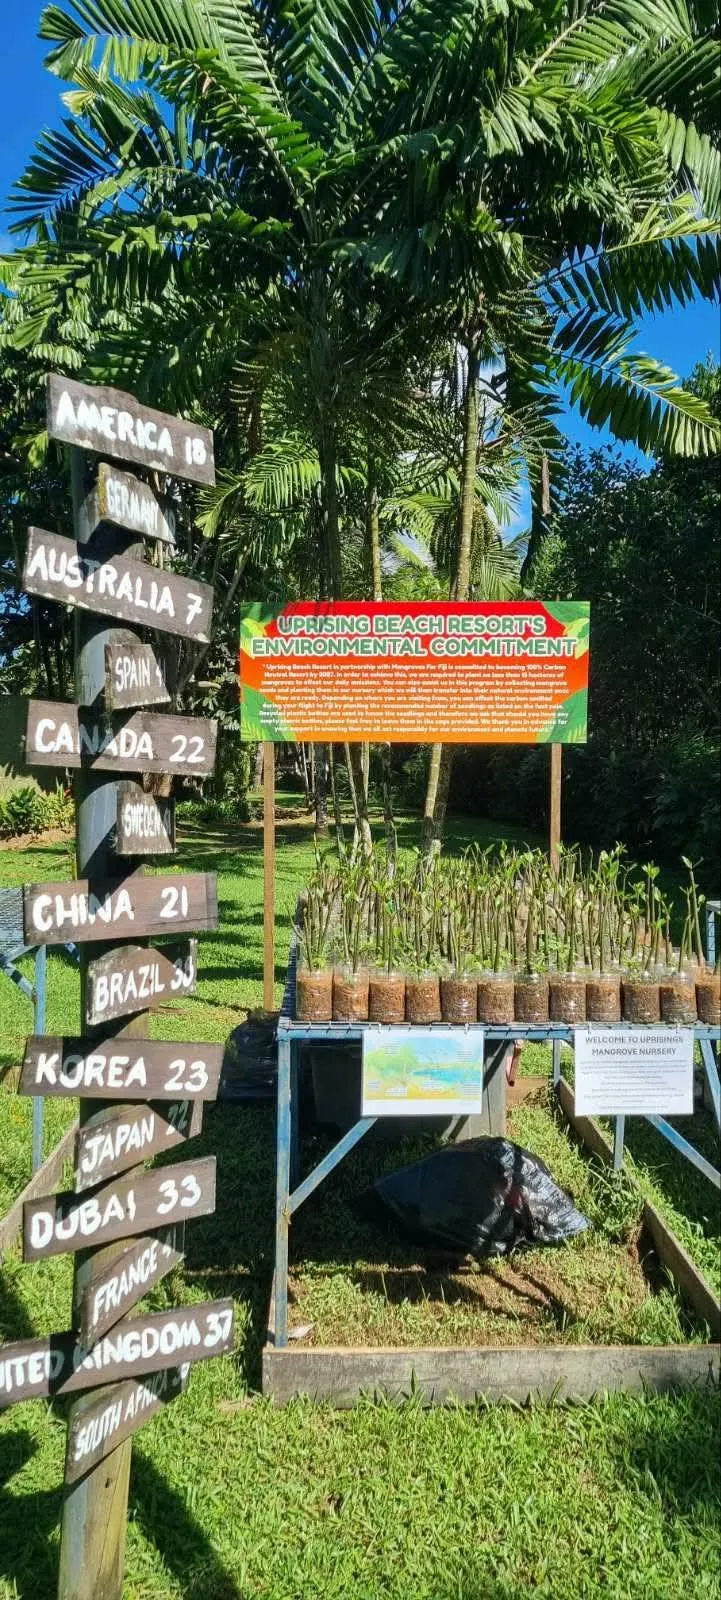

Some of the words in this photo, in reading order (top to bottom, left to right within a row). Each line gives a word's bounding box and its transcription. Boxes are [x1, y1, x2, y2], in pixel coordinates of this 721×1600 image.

[55, 391, 174, 457] AMERICA
[184, 436, 206, 465] 18
[106, 478, 159, 534] GERMANY
[27, 544, 175, 618] AUSTRALIA
[186, 592, 203, 624] 7
[252, 637, 426, 656] ENVIRONMENTAL
[430, 637, 577, 656] COMMITMENT
[277, 615, 372, 635] UPRISING
[373, 615, 443, 635] BEACH
[448, 615, 546, 635] RESORT'S
[115, 655, 151, 692] SPAIN
[34, 718, 154, 760] CANADA
[169, 735, 205, 763] 22
[121, 802, 161, 838] SWEDEN
[32, 889, 134, 932] CHINA
[160, 885, 188, 918] 21
[95, 963, 165, 1012] BRAZIL
[585, 1036, 625, 1044] WELCOME
[628, 1036, 640, 1044] TO
[641, 1035, 684, 1044] UPRISINGS
[591, 1047, 638, 1056] MANGROVE
[639, 1047, 677, 1055] NURSERY
[34, 1052, 146, 1089] KOREA
[164, 1059, 209, 1092] 23
[81, 1112, 155, 1173] JAPAN
[165, 1100, 189, 1135] 22
[30, 1189, 136, 1249] DUBAI
[158, 1175, 201, 1215] 33
[92, 1240, 158, 1326] FRANCE
[72, 1319, 201, 1373] KINGDOM
[203, 1309, 233, 1347] 37
[74, 1399, 122, 1461] SOUTH
[124, 1368, 168, 1422] AFRICA
